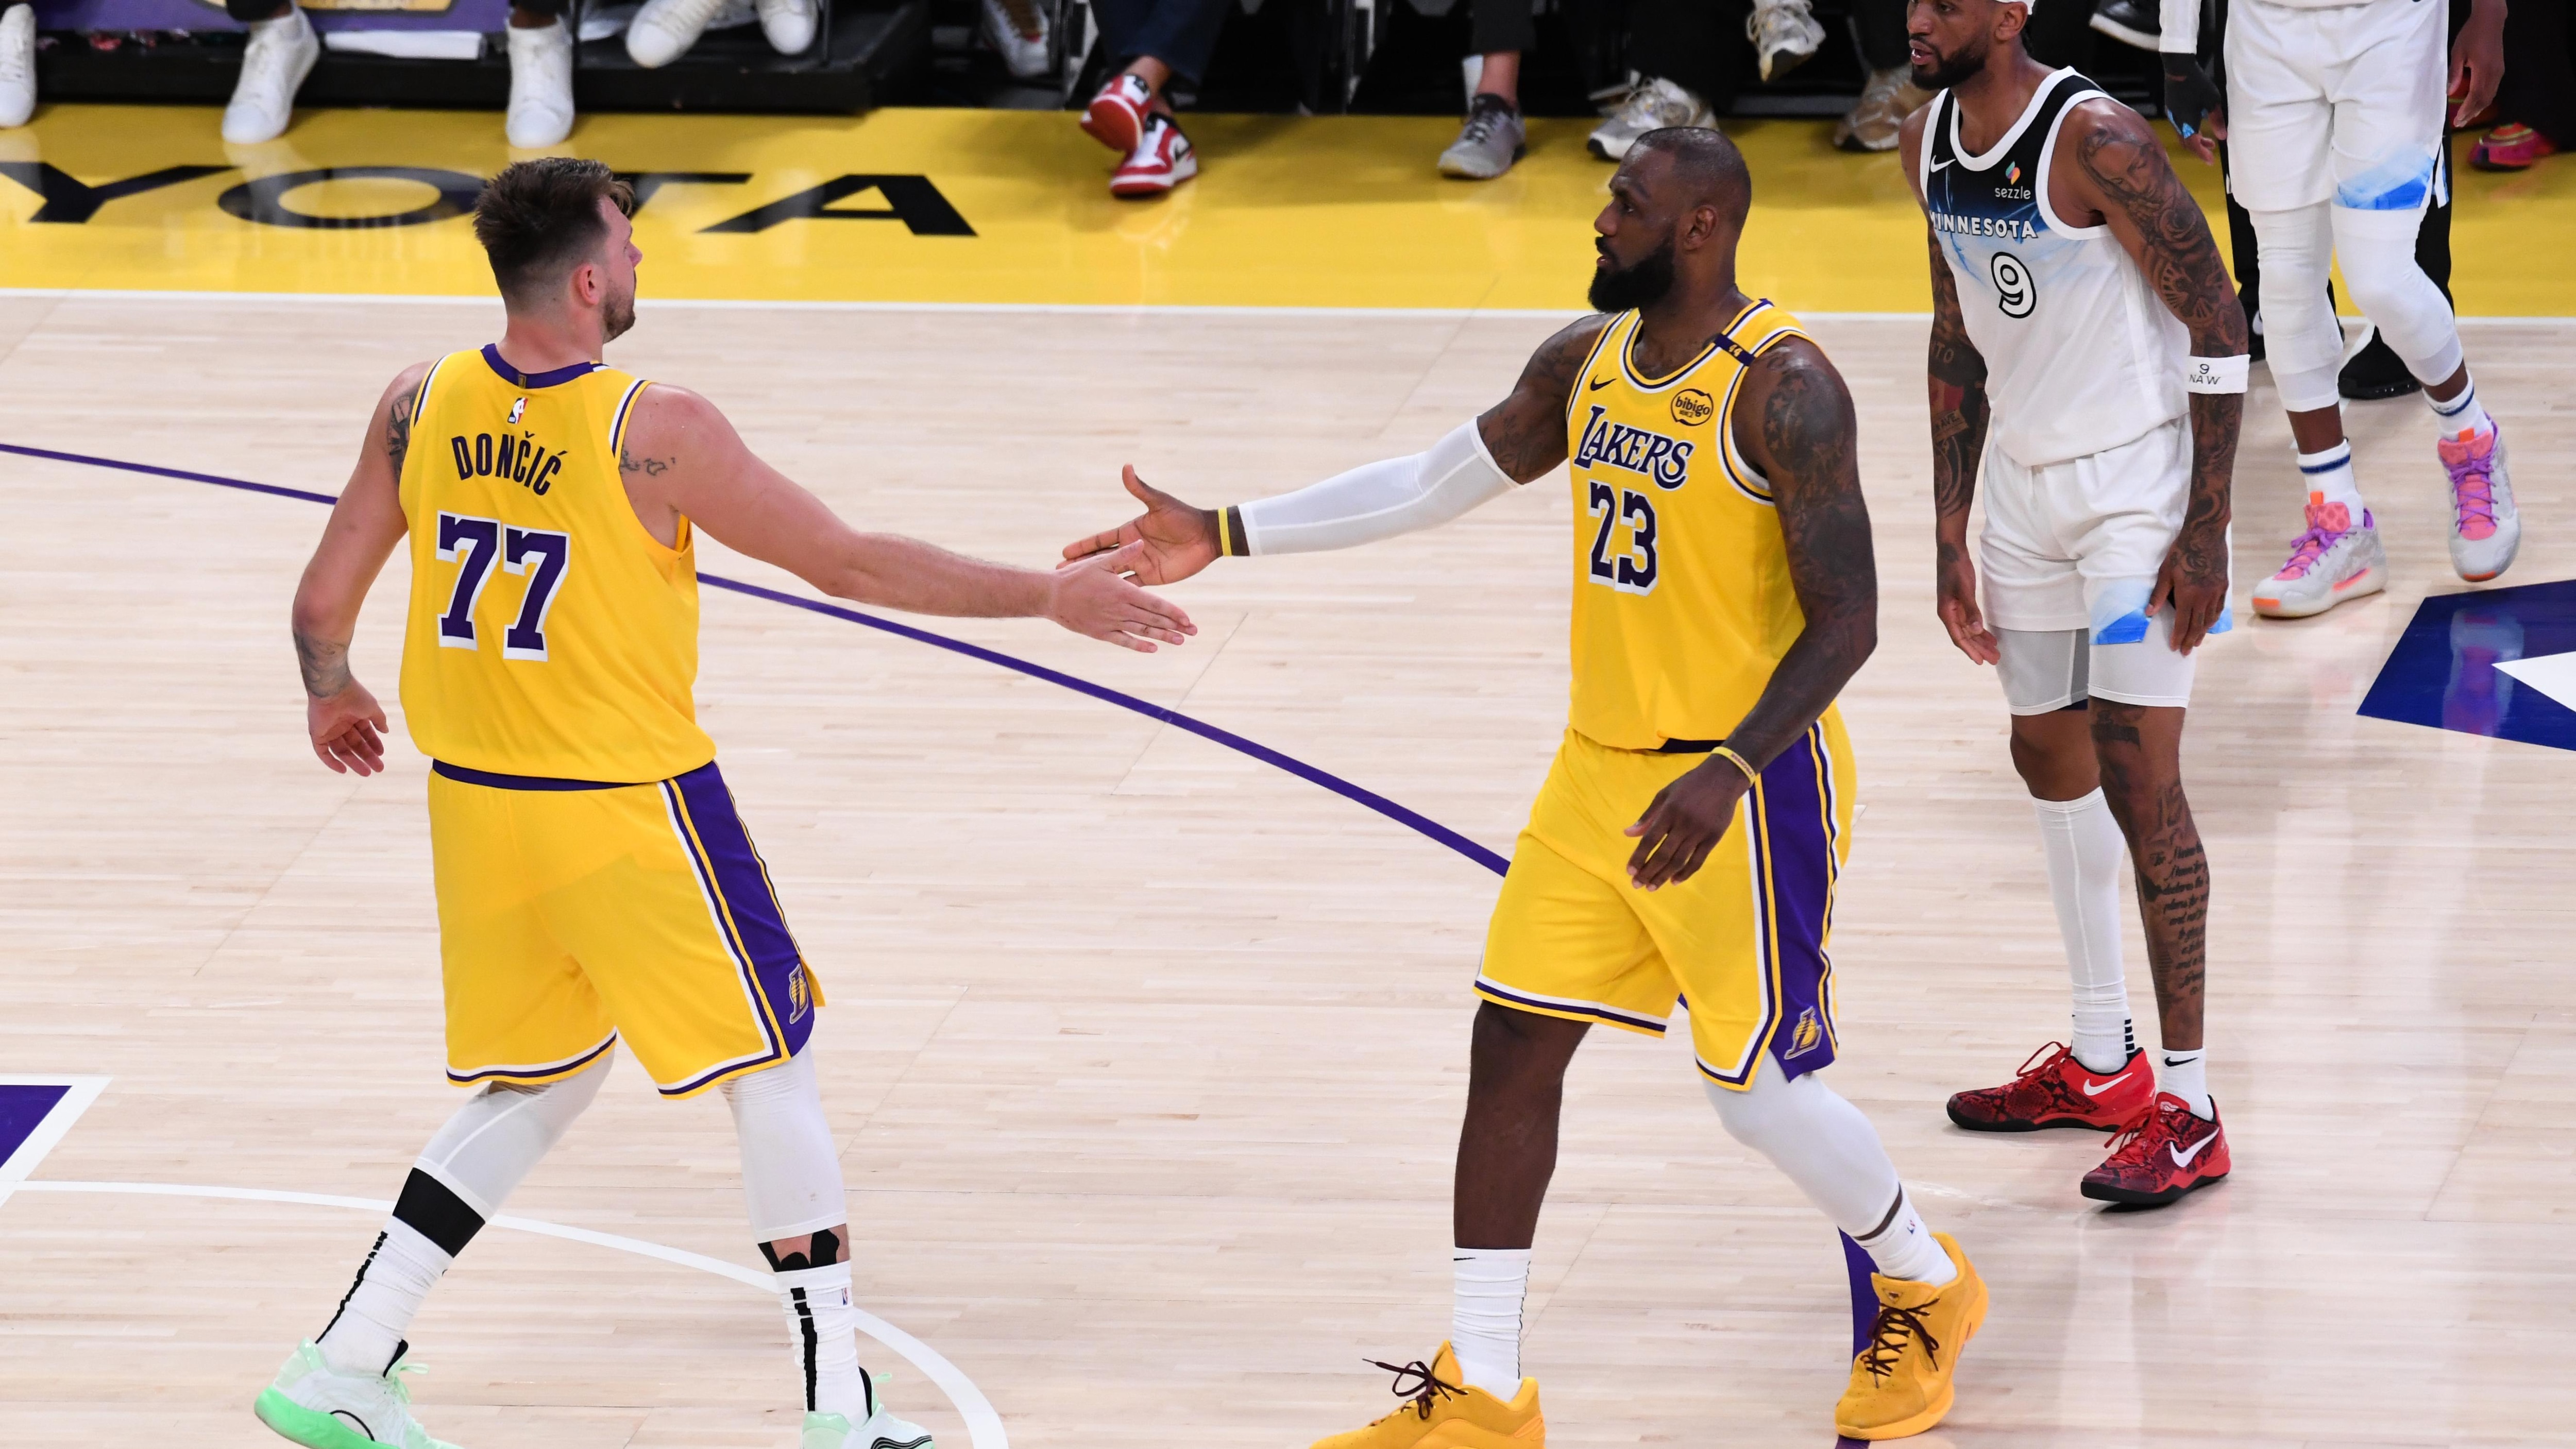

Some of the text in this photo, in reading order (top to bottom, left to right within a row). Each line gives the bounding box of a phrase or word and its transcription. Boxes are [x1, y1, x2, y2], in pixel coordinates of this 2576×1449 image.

[1995, 186, 2031, 199] sezzle
[1991, 251, 2037, 319] 9
[2199, 364, 2210, 374] 9
[1675, 396, 1710, 417] bibigo
[451, 431, 568, 496] DONČIĆ
[1573, 404, 1694, 491] LAKERS
[1588, 479, 1658, 597] 23
[436, 510, 570, 662] 77
